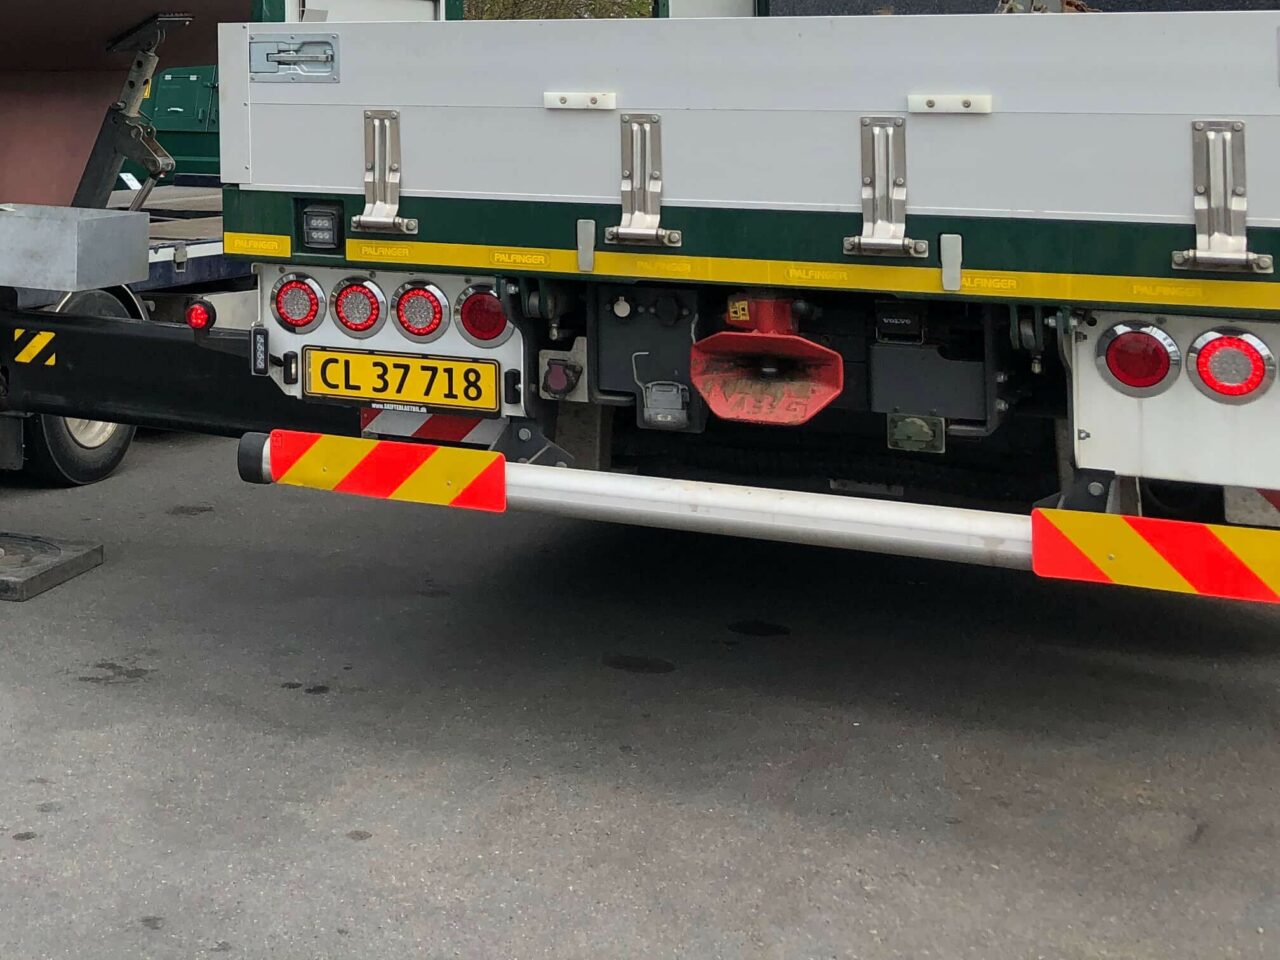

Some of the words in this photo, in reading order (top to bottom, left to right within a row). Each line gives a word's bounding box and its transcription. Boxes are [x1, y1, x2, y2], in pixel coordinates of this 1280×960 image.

[361, 245, 410, 257] PALFINGER
[494, 252, 546, 265] PALFINGER
[789, 268, 848, 281] PALFINGER
[960, 276, 1017, 290] ALFINGER
[320, 357, 362, 391] CL
[371, 361, 411, 395] 37
[420, 365, 483, 402] 718
